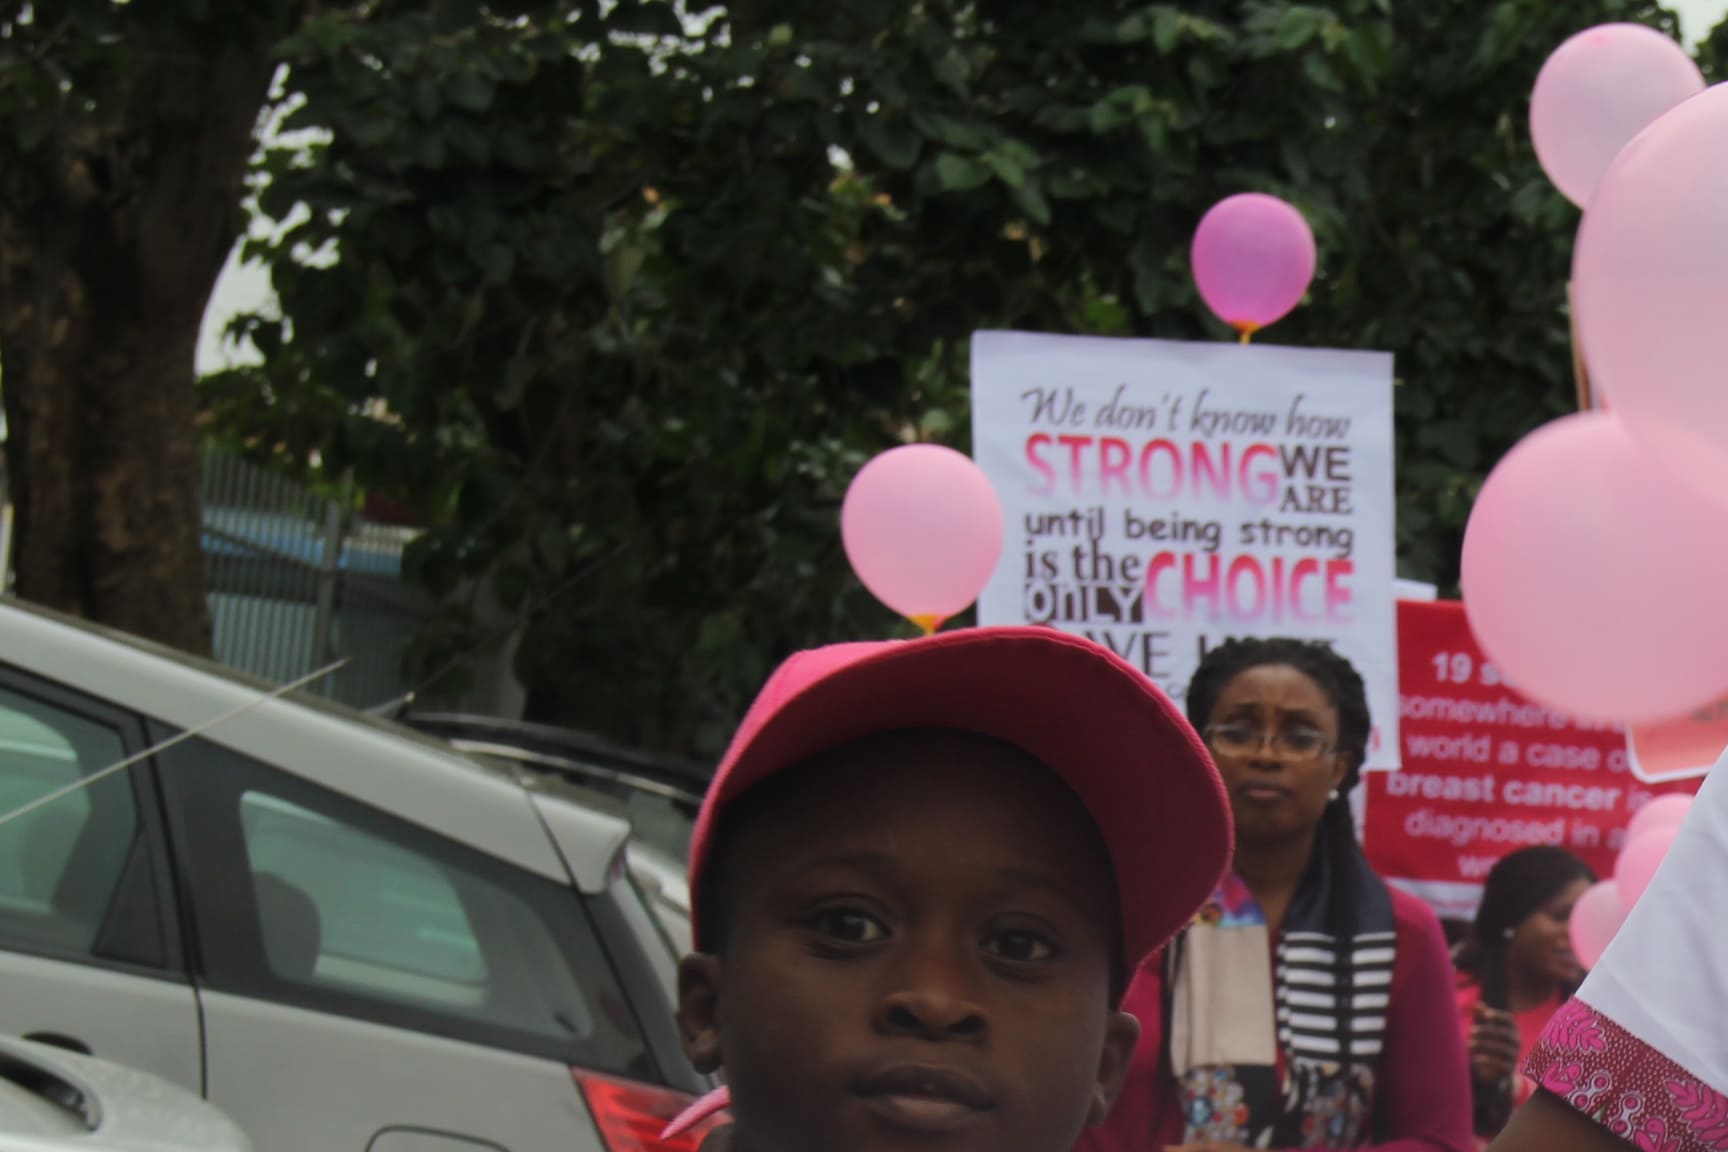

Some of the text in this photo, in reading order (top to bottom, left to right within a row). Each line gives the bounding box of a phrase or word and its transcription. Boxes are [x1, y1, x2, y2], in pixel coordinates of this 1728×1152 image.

[1021, 385, 1351, 440] We don't know how
[1024, 432, 1351, 507] STRONG WE
[1280, 486, 1353, 515] ARE
[1025, 507, 1354, 559] until being strong
[1025, 539, 1141, 583] is the
[1144, 551, 1354, 626] CHOICE
[1432, 651, 1472, 683] 19
[1406, 733, 1492, 763] world
[1498, 740, 1518, 764] a
[1525, 742, 1600, 770] case
[1386, 771, 1496, 801] breast
[1503, 780, 1621, 810] cancer
[1404, 809, 1565, 846] diagnosed
[1572, 818, 1600, 847] in
